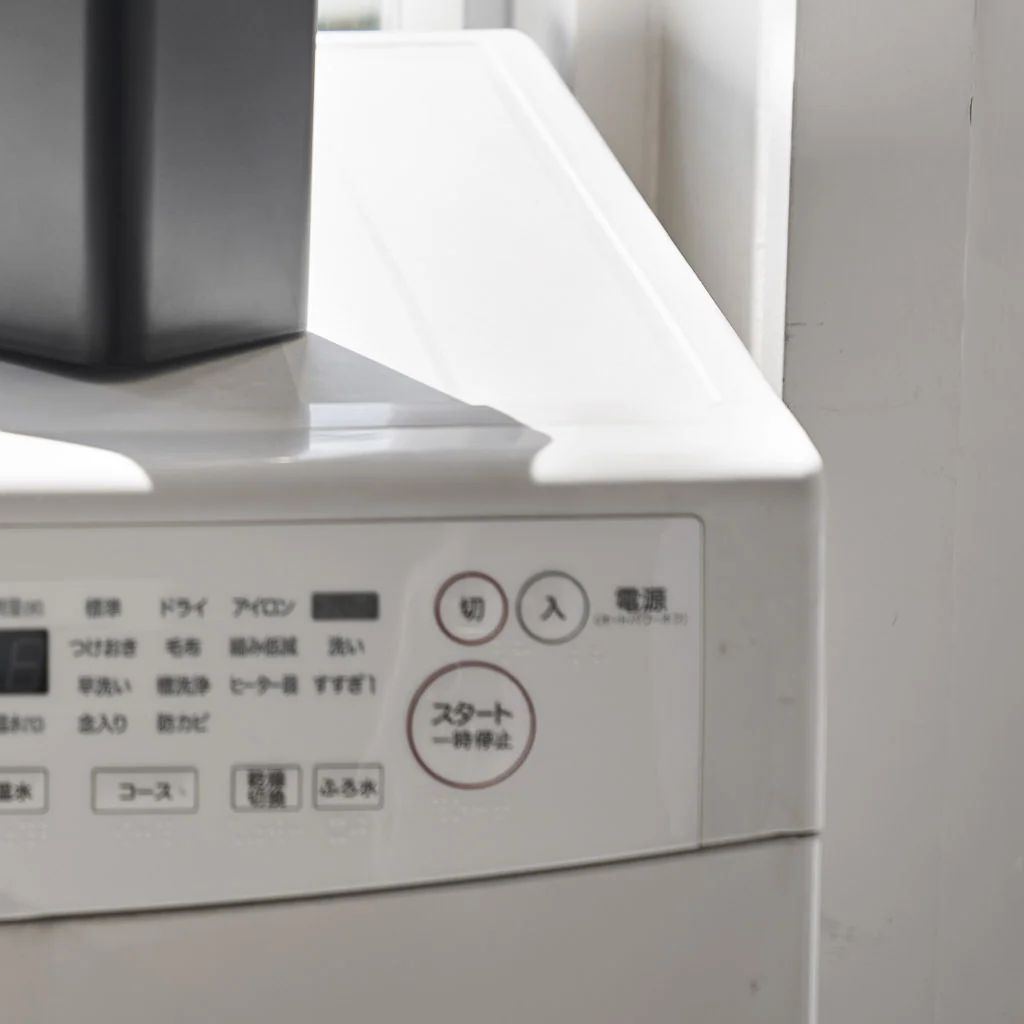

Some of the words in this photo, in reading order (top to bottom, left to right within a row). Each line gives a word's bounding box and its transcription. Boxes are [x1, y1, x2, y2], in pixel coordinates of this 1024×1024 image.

[84, 597, 122, 619] 標準
[160, 596, 208, 618] ドライ
[232, 596, 297, 618] アイロン
[459, 596, 485, 622] 切
[540, 595, 566, 622] 入
[615, 586, 668, 613] 電源
[70, 637, 138, 659] つけおき
[165, 636, 202, 658] 毛布
[328, 635, 365, 657] 洗い
[78, 675, 132, 697] 早洗い
[156, 712, 211, 734] 防カビ
[431, 700, 514, 727] スタート
[432, 729, 513, 751] 一時停止
[118, 780, 173, 802] コース
[319, 776, 377, 799] ふろ水
